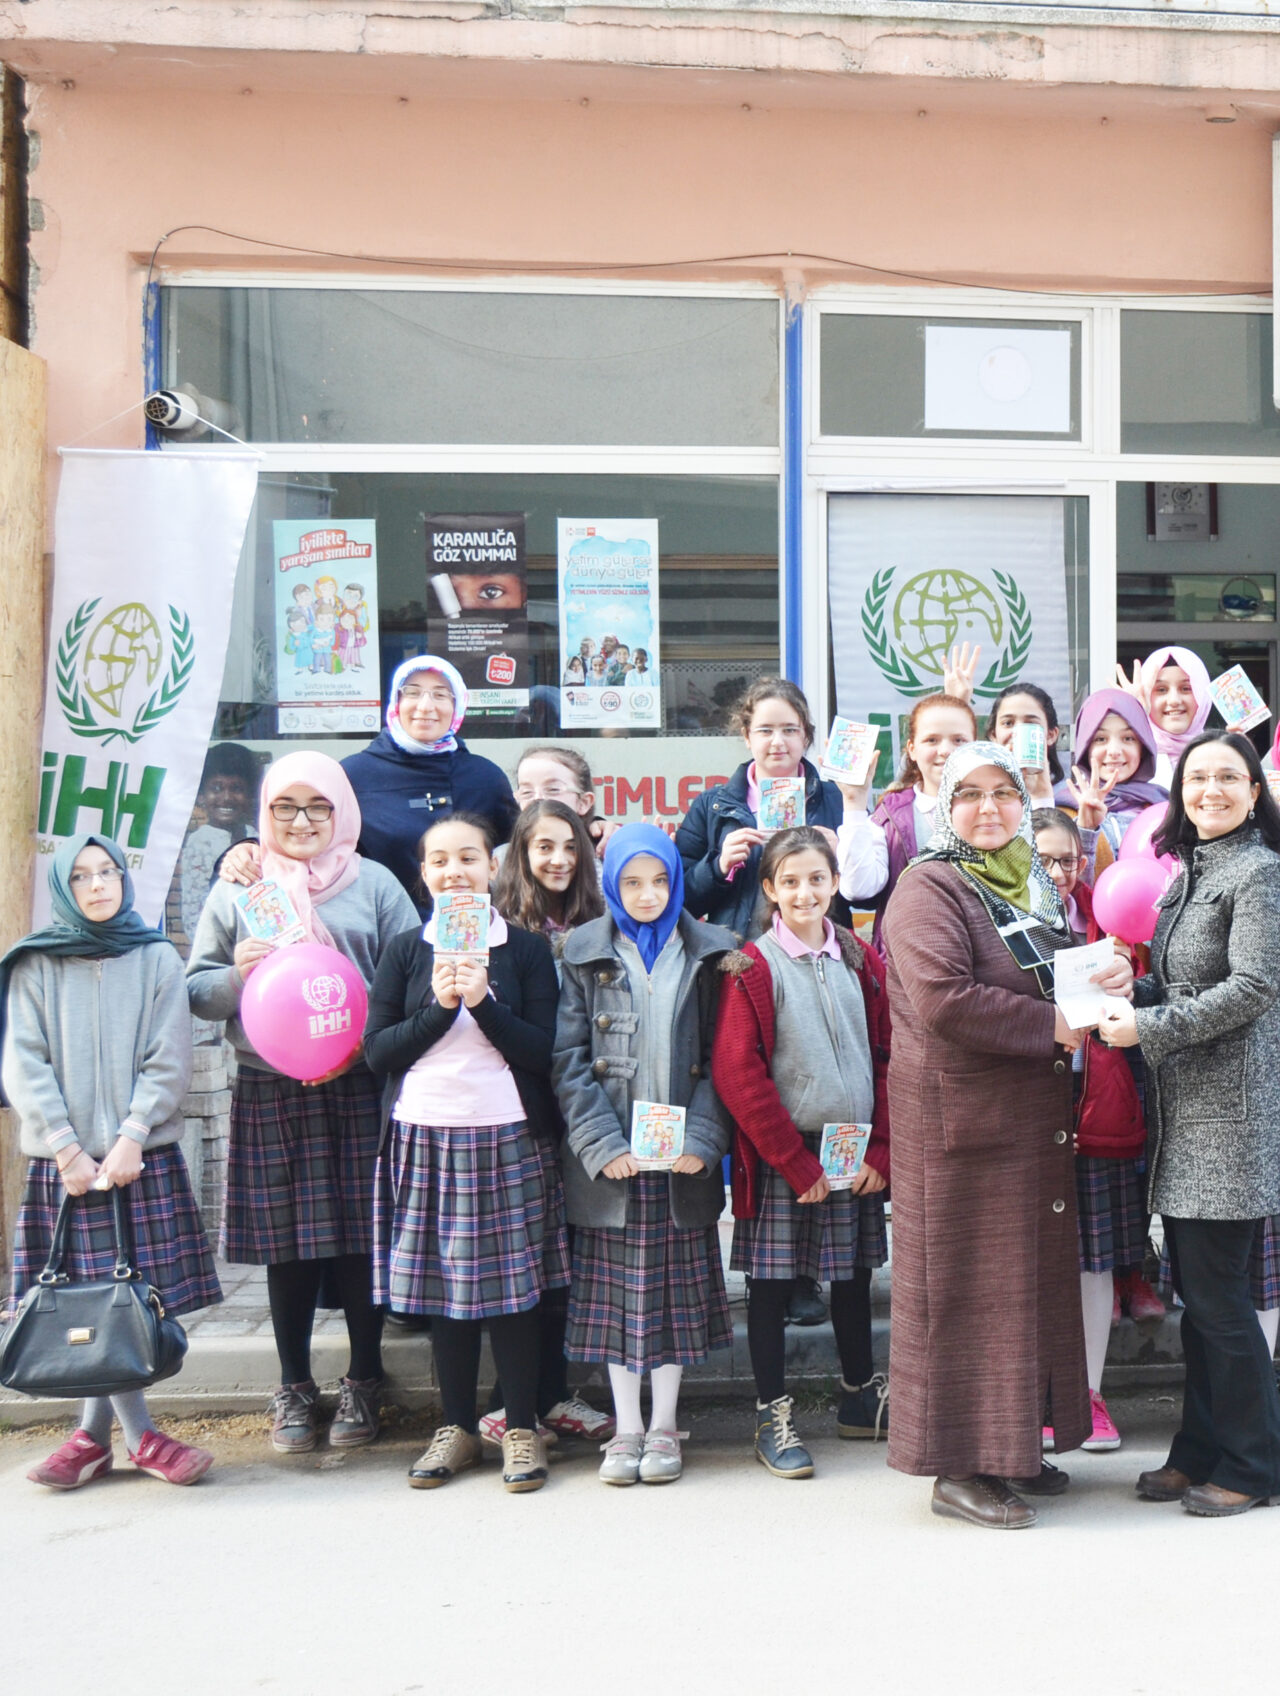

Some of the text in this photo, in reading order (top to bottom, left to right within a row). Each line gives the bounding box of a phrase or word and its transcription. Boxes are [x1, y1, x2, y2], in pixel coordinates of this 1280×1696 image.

[433, 528, 517, 547] KARANLIĞA
[433, 547, 517, 562] GÖZ YUMMA!
